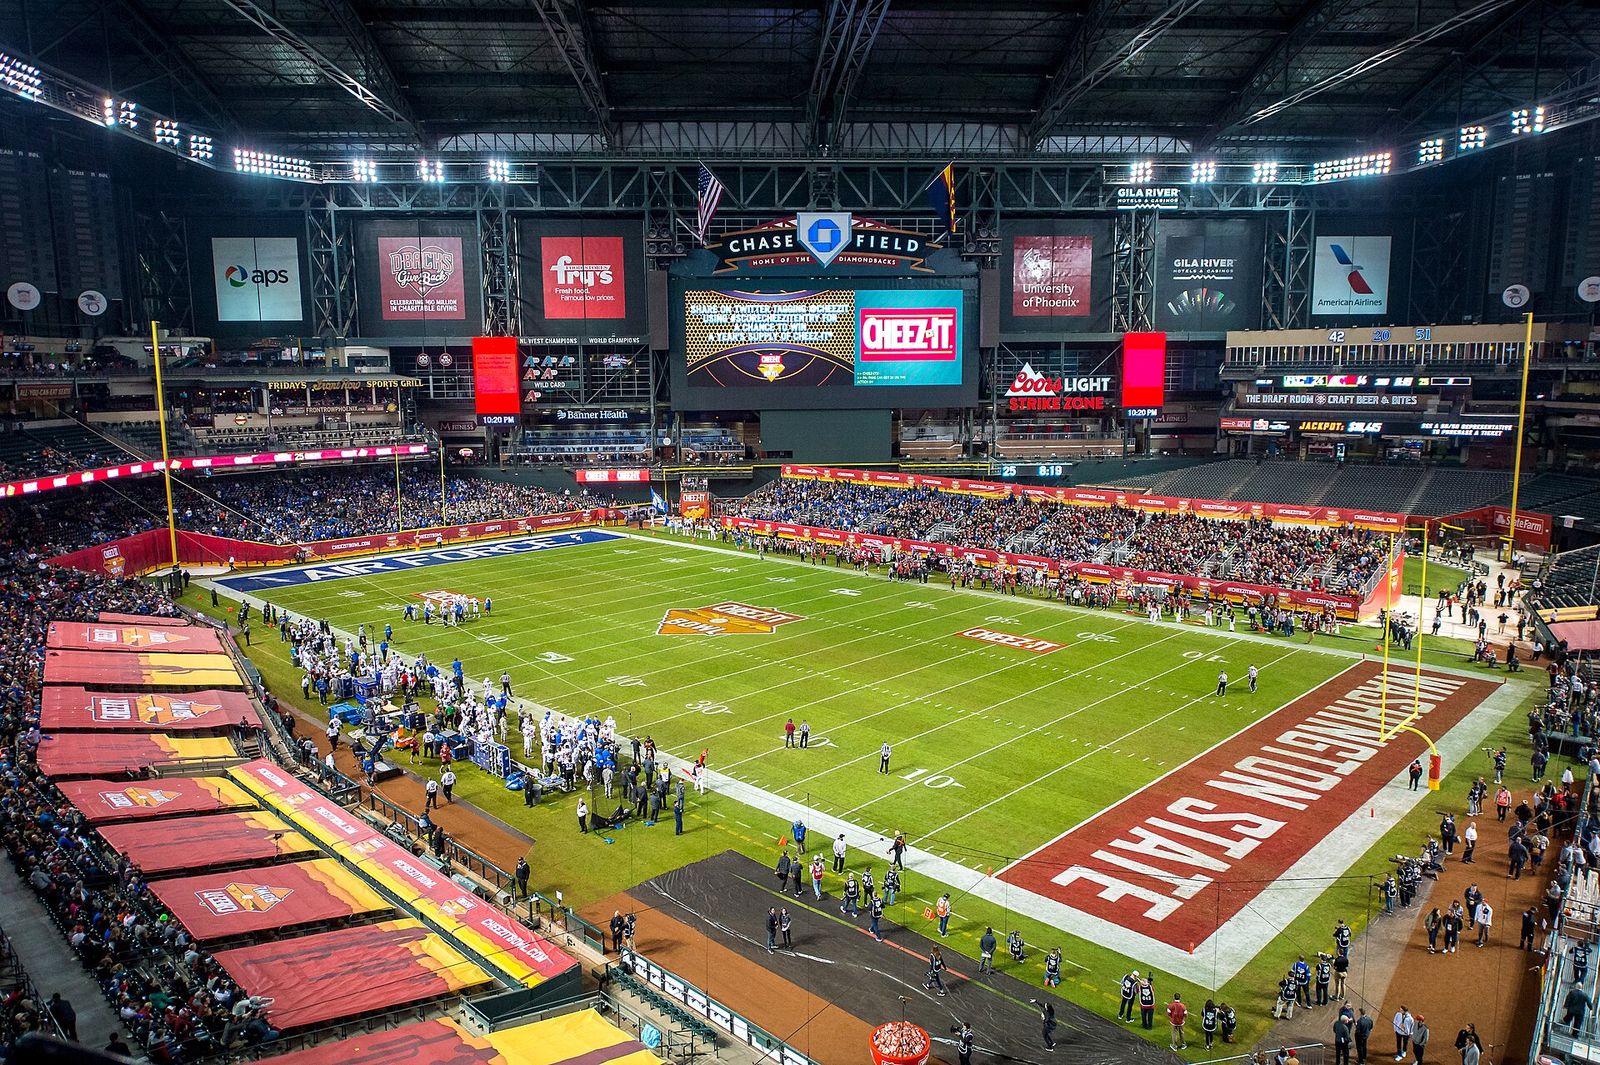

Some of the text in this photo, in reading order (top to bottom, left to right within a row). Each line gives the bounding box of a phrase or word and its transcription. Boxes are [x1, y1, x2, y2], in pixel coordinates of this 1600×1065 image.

[1118, 188, 1178, 197] GILA RIVER
[729, 235, 919, 253] CHASE FIELD
[752, 258, 775, 266] HOME
[838, 256, 896, 266] DIAMONDBACKS
[1174, 259, 1234, 268] GILA RIVER
[550, 256, 613, 287] fry's
[251, 268, 288, 288] aps
[398, 269, 448, 288] Give Back
[1023, 284, 1074, 296] University
[1022, 297, 1034, 308] of
[1318, 298, 1382, 307] American Airlines
[691, 305, 716, 314] SHARE
[718, 305, 730, 314] ON
[733, 305, 768, 314] TWITTER
[770, 305, 806, 314] TAGGING
[703, 314, 728, 323] USING
[741, 324, 774, 332] CHANCE
[777, 324, 788, 332] TO
[790, 324, 806, 332] WIN
[748, 332, 778, 342] SUPPLY
[780, 332, 792, 342] OF
[1328, 331, 1345, 342] 42
[1372, 330, 1391, 341] 20
[366, 380, 398, 388] SPORTS
[401, 379, 423, 387] GRILL
[1010, 366, 1111, 392] Coors LIGHT
[1010, 396, 1104, 410] STRIKE ZONE
[1246, 395, 1261, 403] THE
[1262, 395, 1288, 404] DRAFT
[1290, 395, 1314, 404] ROOM
[1328, 395, 1355, 404] CRAFT
[1356, 396, 1379, 404] BEER
[1392, 396, 1417, 405] BITES
[568, 410, 628, 419] Banner Health
[1299, 422, 1345, 430] JACKPOT:
[1003, 466, 1016, 476] 25
[303, 537, 578, 581] AIR FORCE
[1306, 597, 1352, 608] CHEEZITBOWL.COM
[665, 618, 726, 635] BOWL
[898, 768, 956, 789] 10
[1050, 670, 1467, 922] WASHINGTON STATE
[481, 918, 548, 963] CHEEZITBOWL.COM
